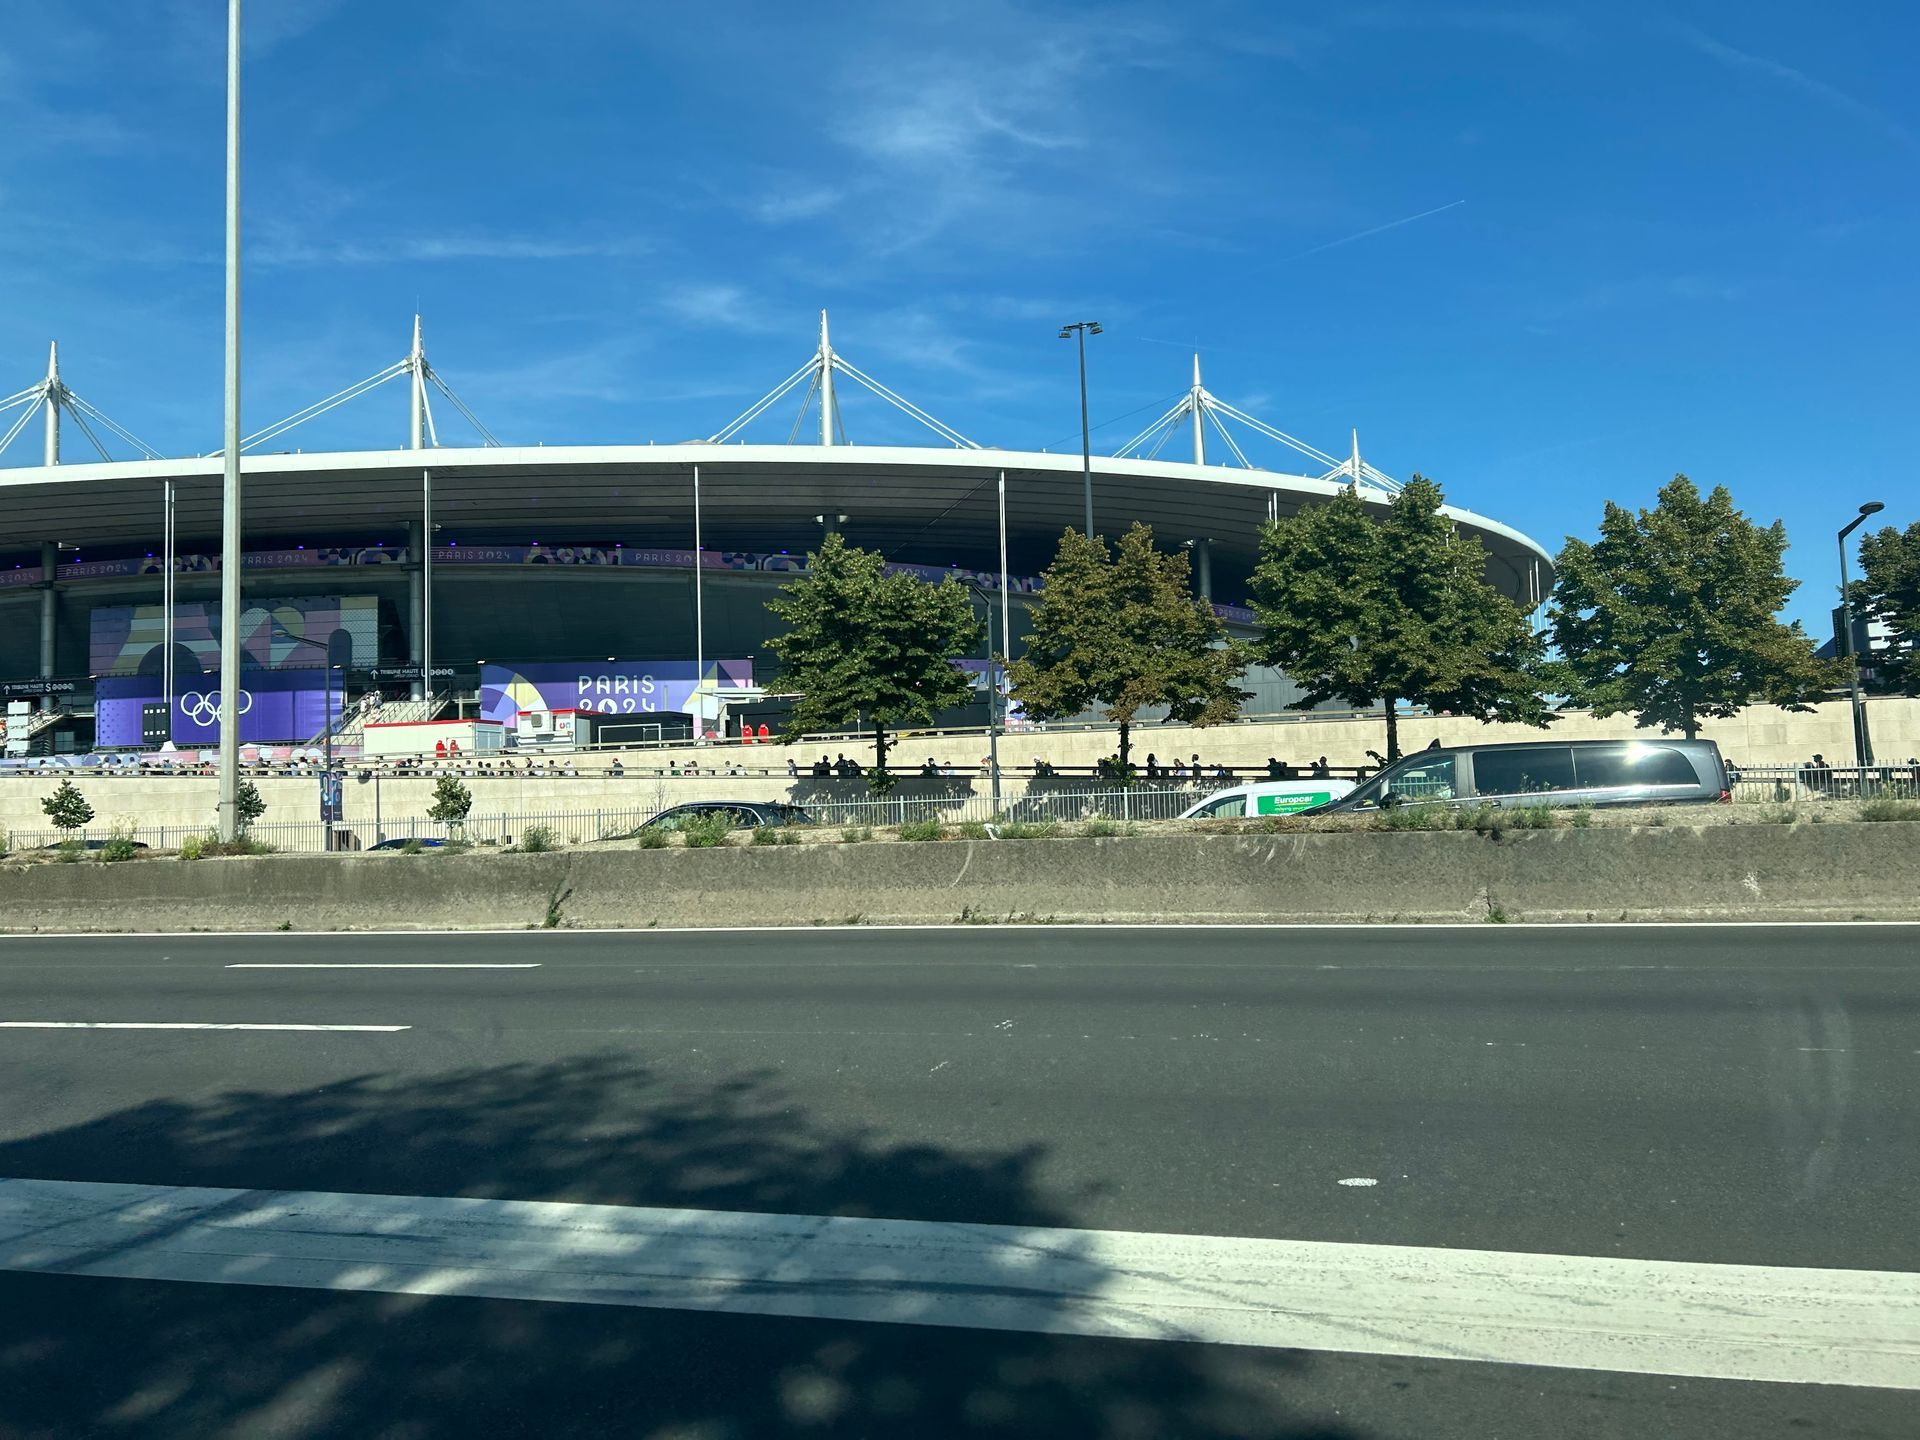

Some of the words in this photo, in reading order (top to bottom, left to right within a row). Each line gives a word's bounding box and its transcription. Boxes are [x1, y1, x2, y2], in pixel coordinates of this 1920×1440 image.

[277, 553, 308, 563] 2024
[478, 551, 510, 560] 2024
[99, 564, 129, 574] 2024
[1274, 795, 1314, 805] Europcar
